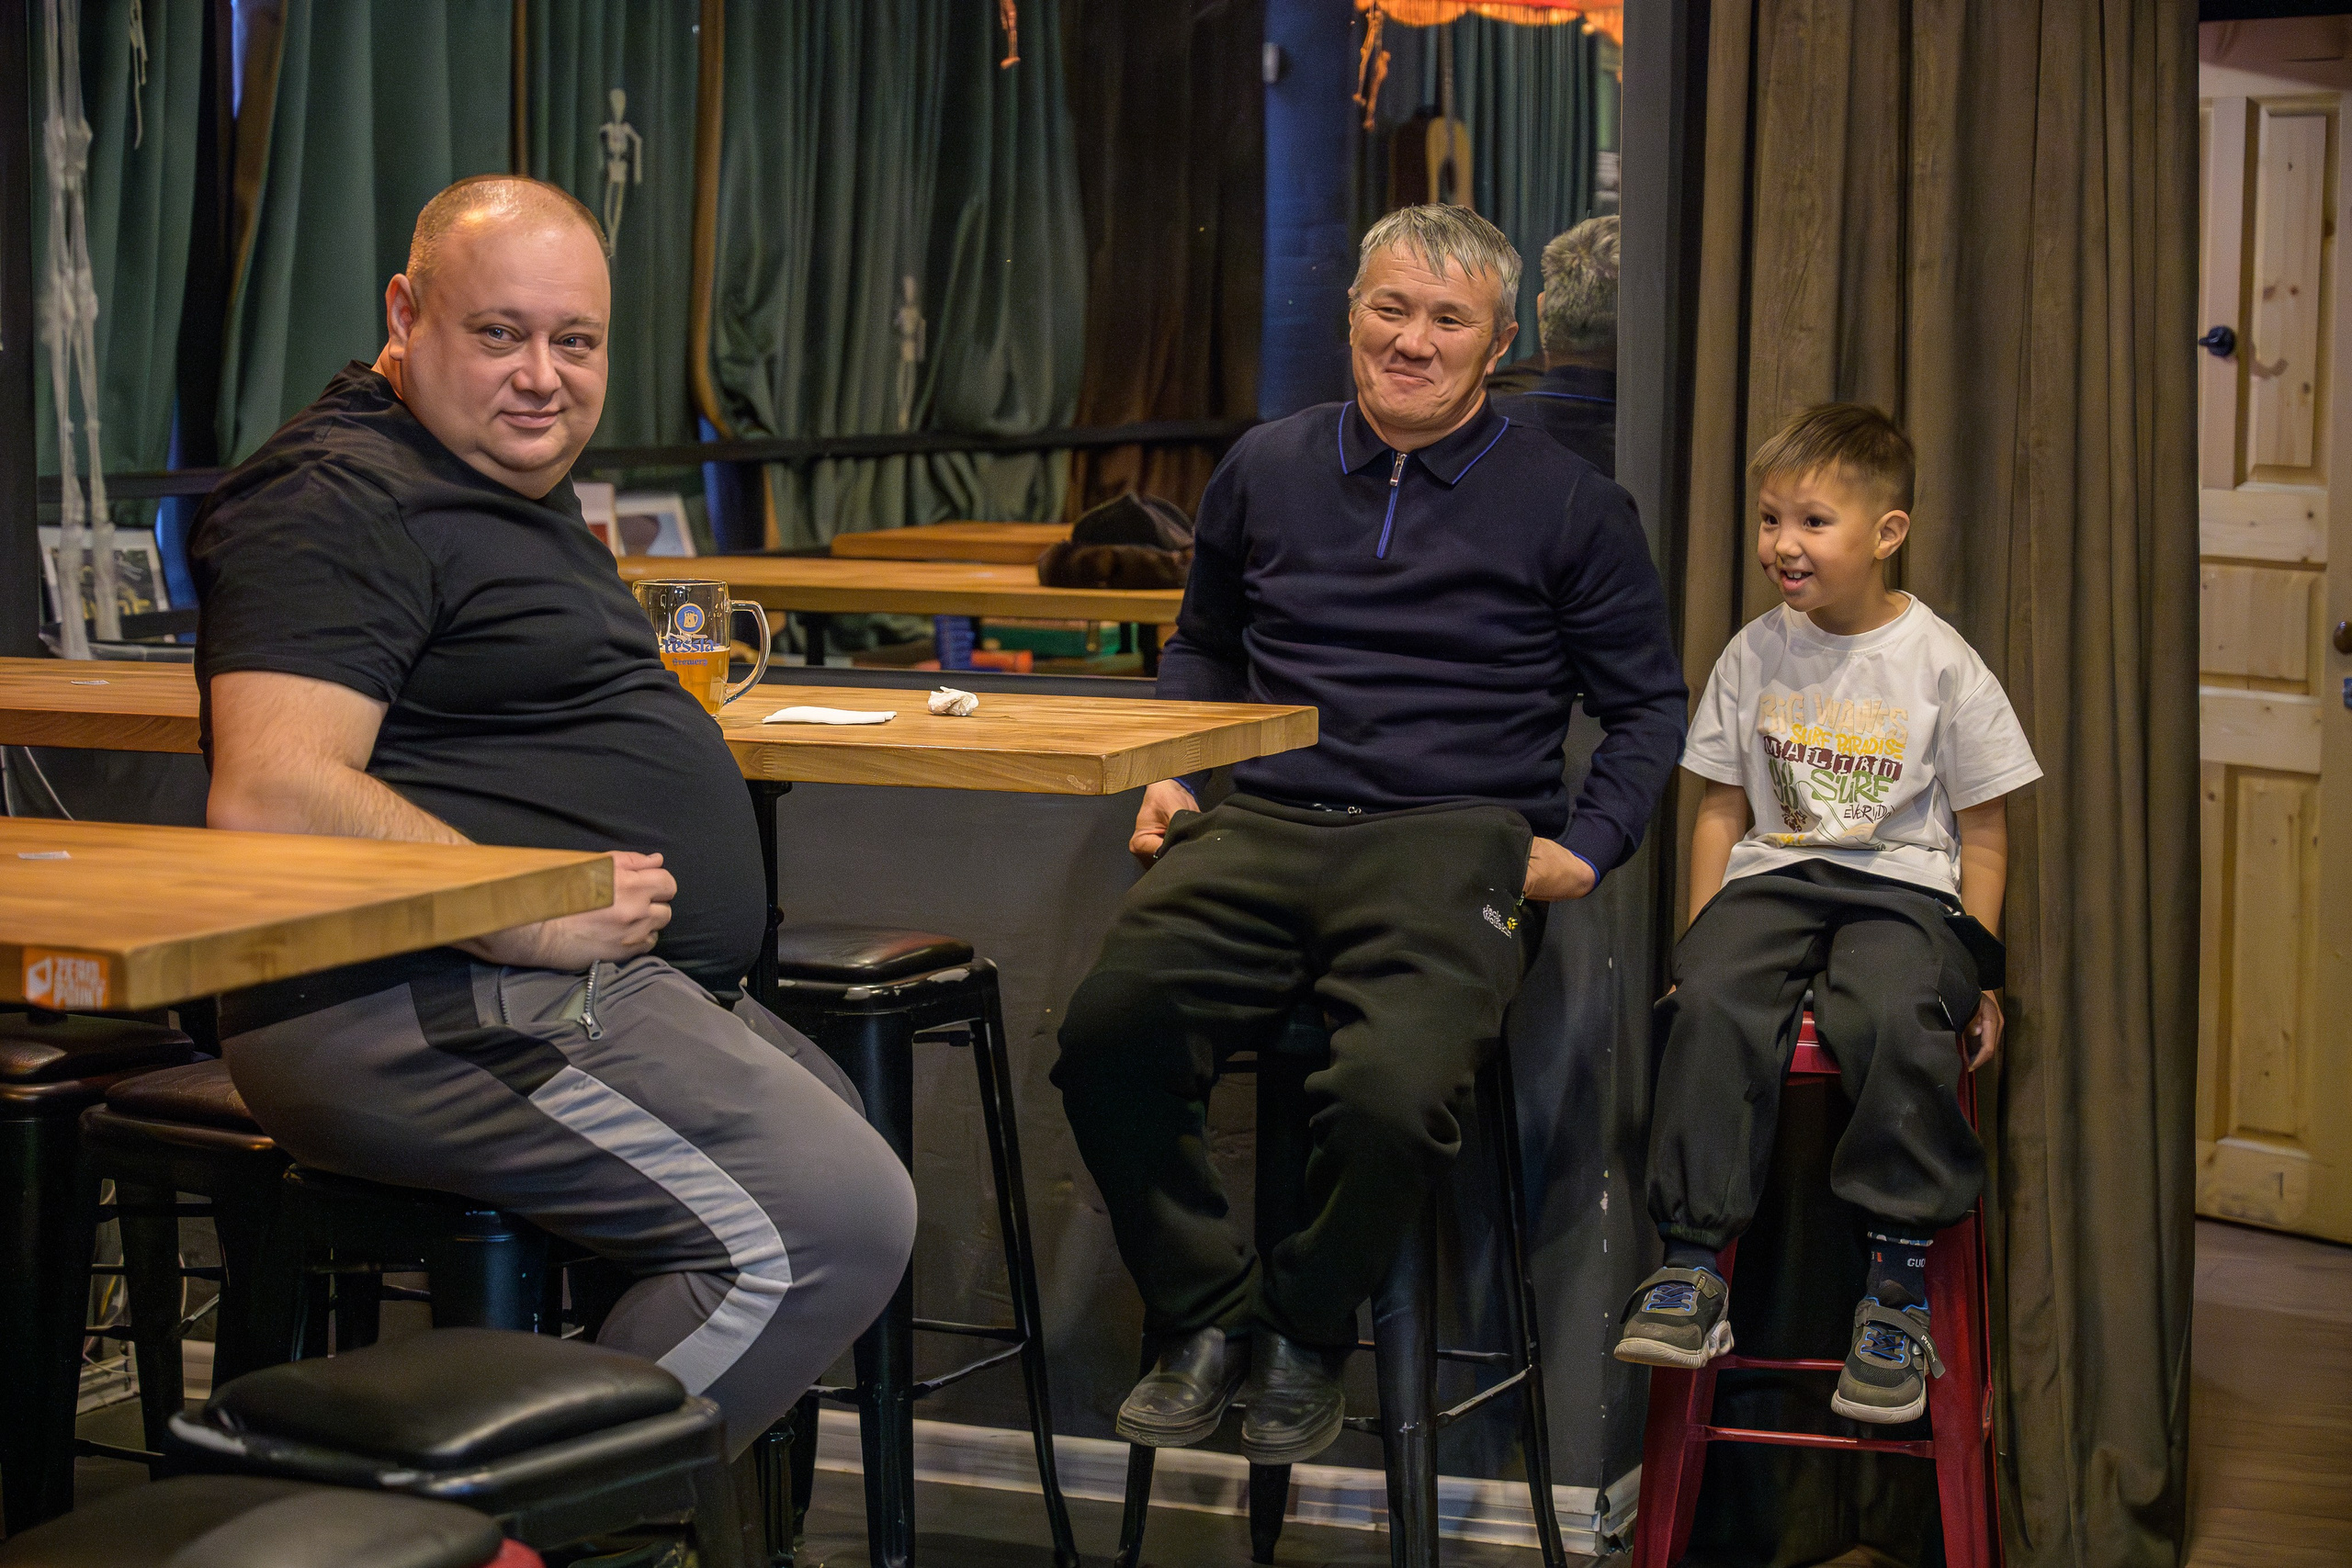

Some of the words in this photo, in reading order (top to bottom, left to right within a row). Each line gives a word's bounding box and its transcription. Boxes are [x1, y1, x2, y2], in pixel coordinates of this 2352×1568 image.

[1764, 736, 1903, 781] MALIBU
[1791, 724, 1832, 749] SURF
[1836, 734, 1905, 760] PARADISE
[1811, 769, 1894, 804] SURF
